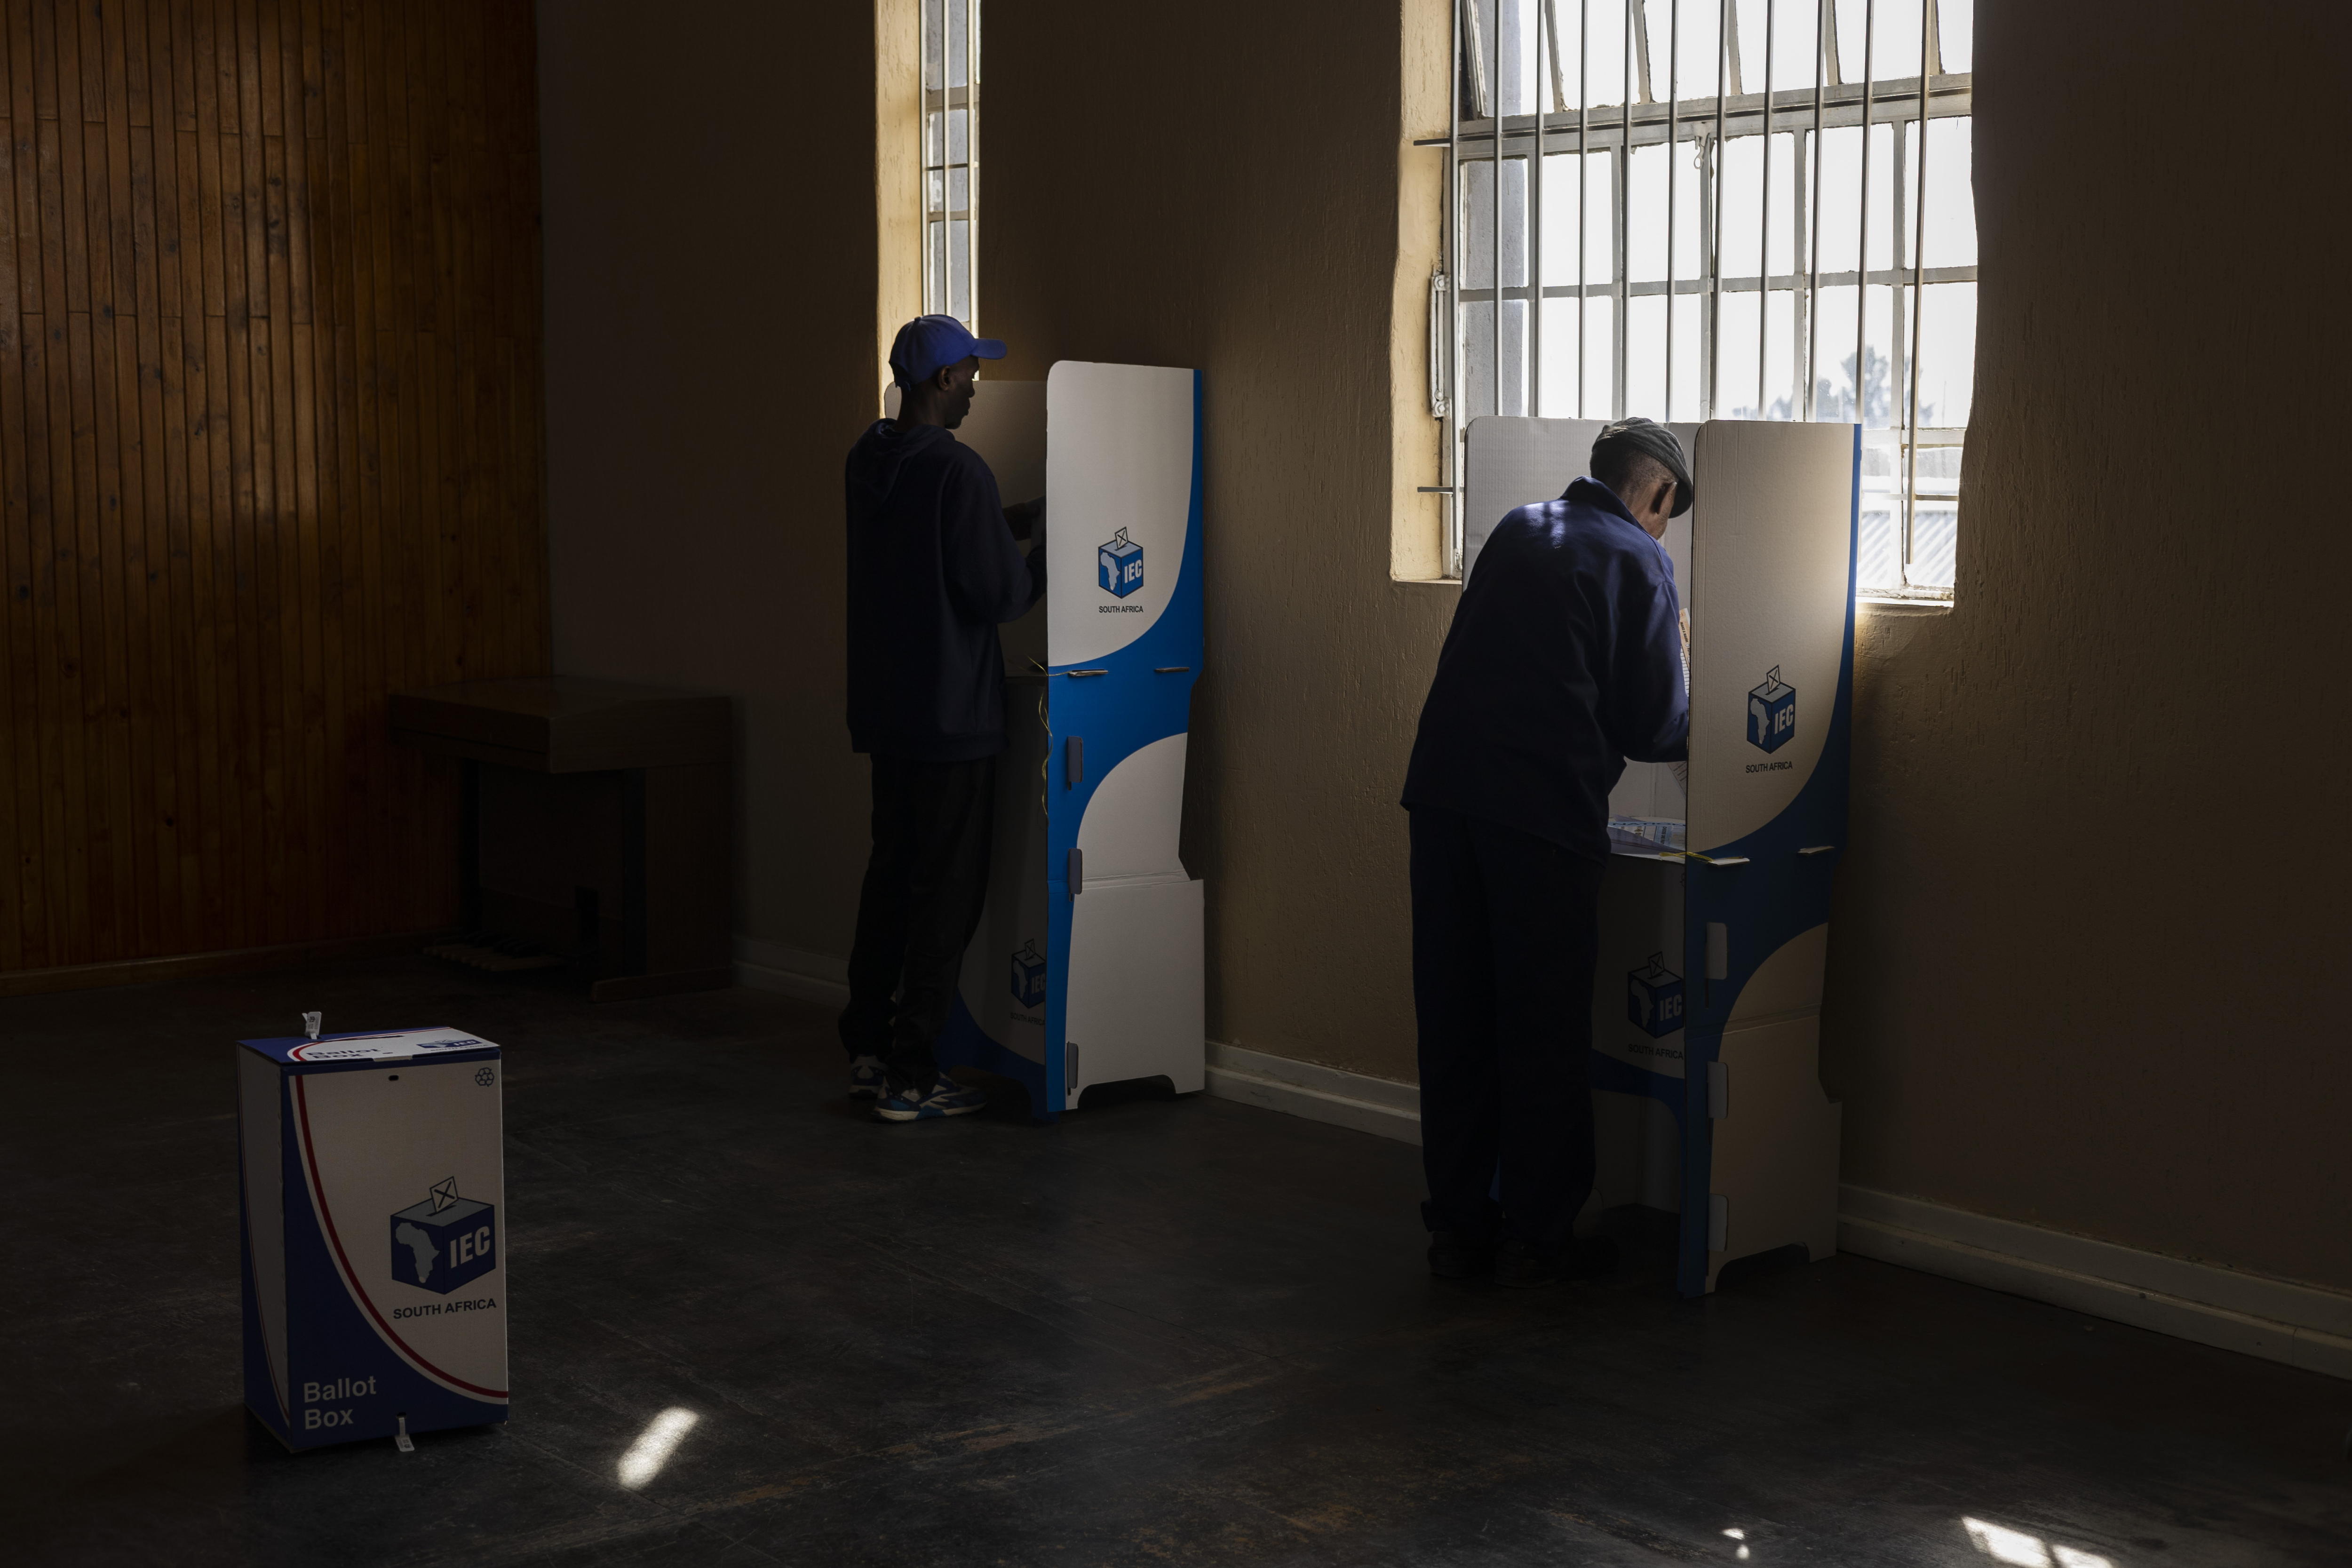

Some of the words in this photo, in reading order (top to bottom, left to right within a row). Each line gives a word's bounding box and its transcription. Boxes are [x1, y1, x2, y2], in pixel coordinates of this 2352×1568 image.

[1124, 559, 1142, 584] IEC
[1774, 704, 1794, 735] IEC
[1746, 763, 1768, 773] SOUTH
[1769, 761, 1793, 771] AFRICA
[1031, 972, 1046, 994] IEC
[1010, 1012, 1027, 1022] SOUTH
[1028, 1016, 1046, 1025] AFRICA
[1659, 994, 1682, 1021] IEC
[1628, 1043, 1654, 1055] SOUTH
[1655, 1048, 1684, 1060] AFRICA
[449, 1225, 491, 1269] IEC
[393, 1304, 442, 1320] SOUTH
[445, 1298, 497, 1313] AFRICA
[303, 1375, 377, 1404] Ballot
[304, 1408, 354, 1431] Box
